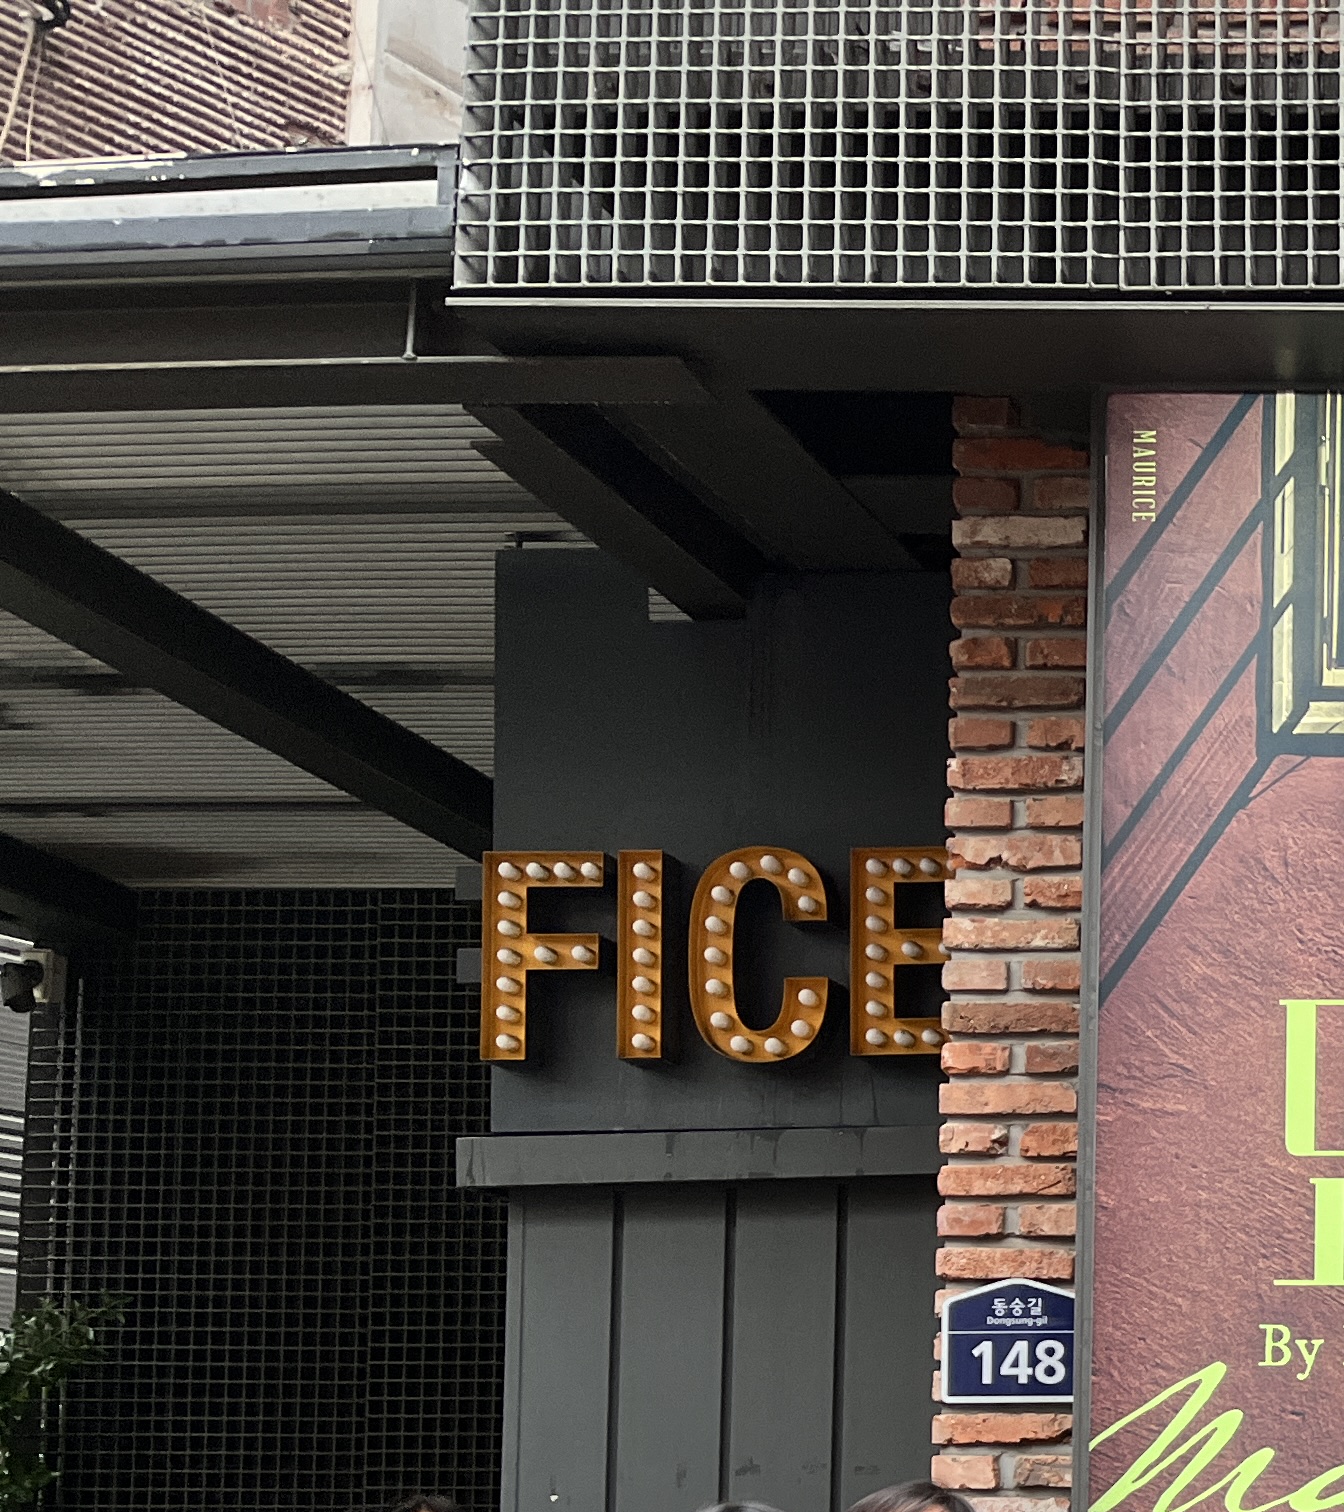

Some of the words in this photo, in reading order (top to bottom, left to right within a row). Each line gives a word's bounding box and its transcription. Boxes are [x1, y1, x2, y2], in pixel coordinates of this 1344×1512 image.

[1132, 430, 1157, 523] MAURICE
[986, 1316, 1048, 1326] Dongsung-gil
[971, 1339, 1066, 1385] 148
[1258, 1323, 1325, 1381] By
